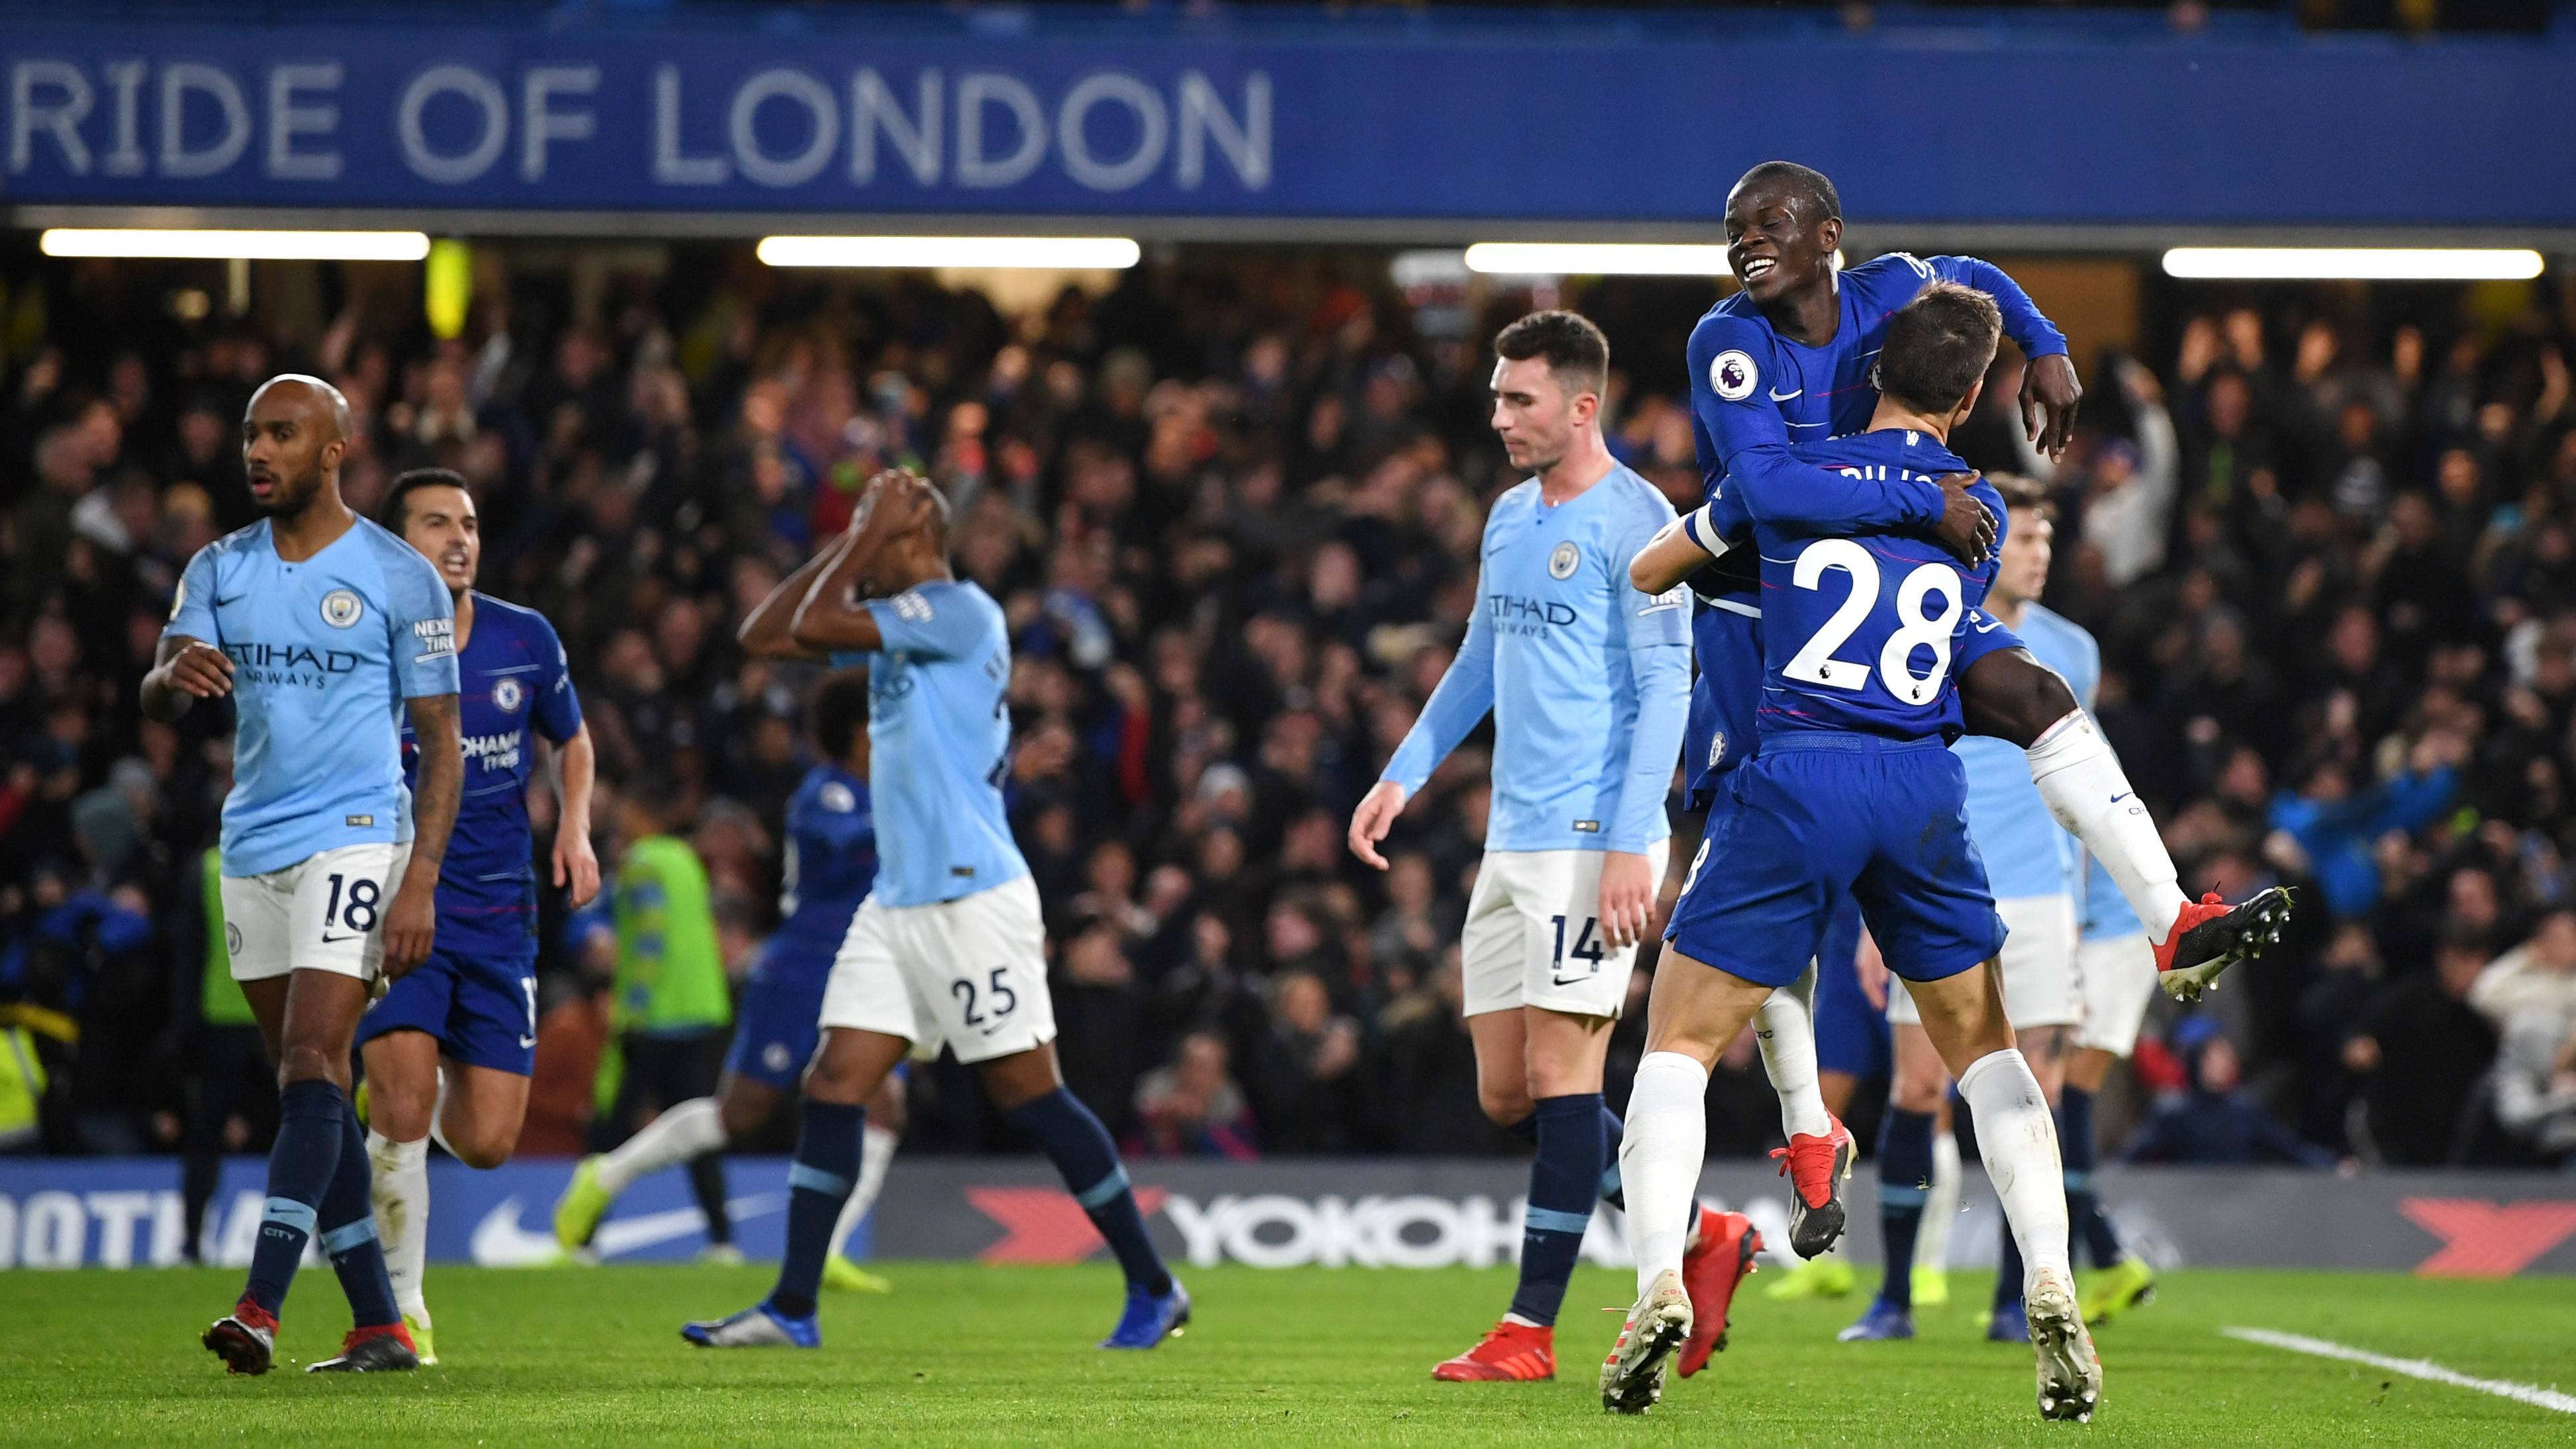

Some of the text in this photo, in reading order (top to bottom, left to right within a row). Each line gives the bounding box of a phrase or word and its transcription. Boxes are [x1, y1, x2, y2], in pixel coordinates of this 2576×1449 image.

[9, 60, 1272, 191] RIDE OF LONDON
[1489, 595, 1578, 626] TIHAD
[1782, 538, 1963, 706] 28
[324, 873, 380, 933] 18
[1551, 915, 1605, 972] 14
[520, 976, 538, 1031] 1
[952, 967, 1016, 1025] 25
[264, 1227, 297, 1242] CITY
